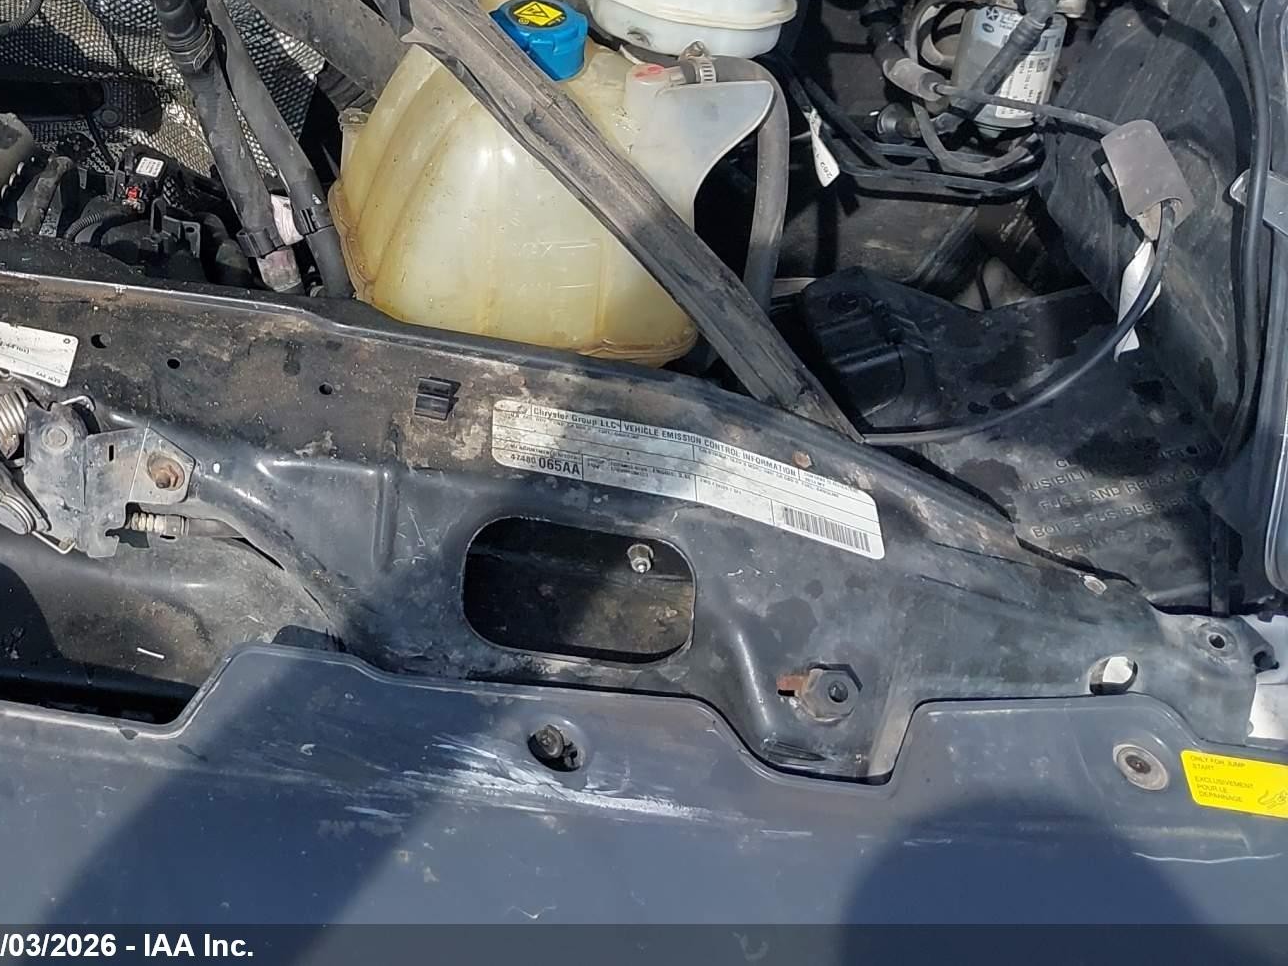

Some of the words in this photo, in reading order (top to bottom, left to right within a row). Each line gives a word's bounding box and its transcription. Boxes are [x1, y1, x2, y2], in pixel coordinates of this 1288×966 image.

[533, 407, 569, 421] Chrysler
[571, 415, 597, 426] Group
[600, 419, 617, 429] LLC
[624, 423, 659, 436] VEHICLE
[661, 430, 702, 445] EMISSION
[704, 438, 740, 457] CONTROL
[742, 452, 797, 476] INFORMATION
[538, 457, 580, 475] 065AA
[1088, 486, 1121, 502] AND
[1125, 472, 1177, 494] RELAY
[1192, 763, 1215, 771] START
[1210, 758, 1225, 766] FOR
[1227, 760, 1246, 768] JUMP
[1197, 784, 1219, 792] POUR
